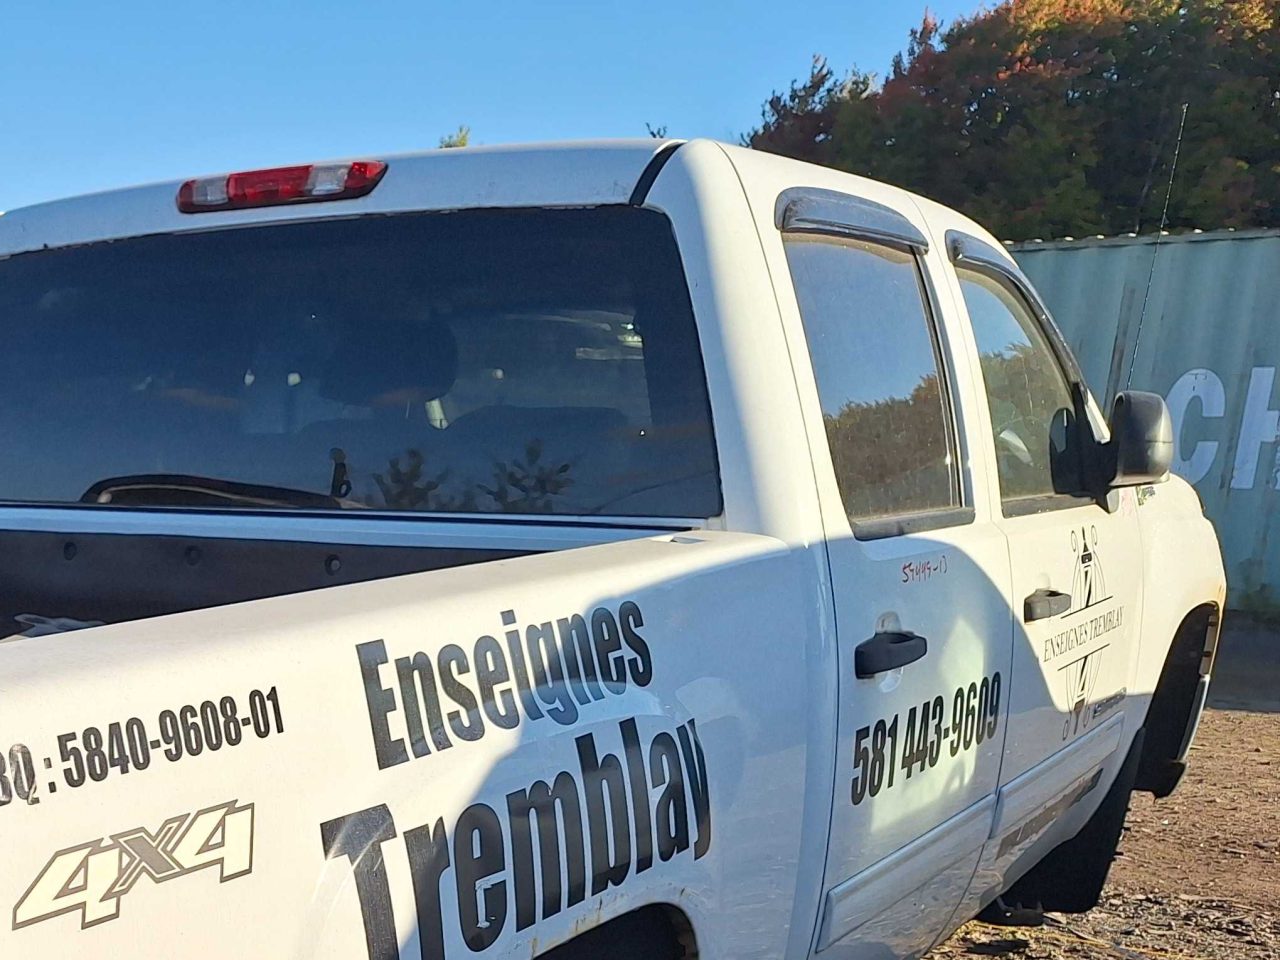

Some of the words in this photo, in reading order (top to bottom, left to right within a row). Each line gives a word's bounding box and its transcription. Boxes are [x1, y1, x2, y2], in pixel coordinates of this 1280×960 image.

[1043, 623, 1089, 662] ENSEIGNES
[1088, 605, 1125, 641] TREMBLAY
[356, 600, 653, 770] Enseignes
[57, 686, 284, 788] 5840-9608-01
